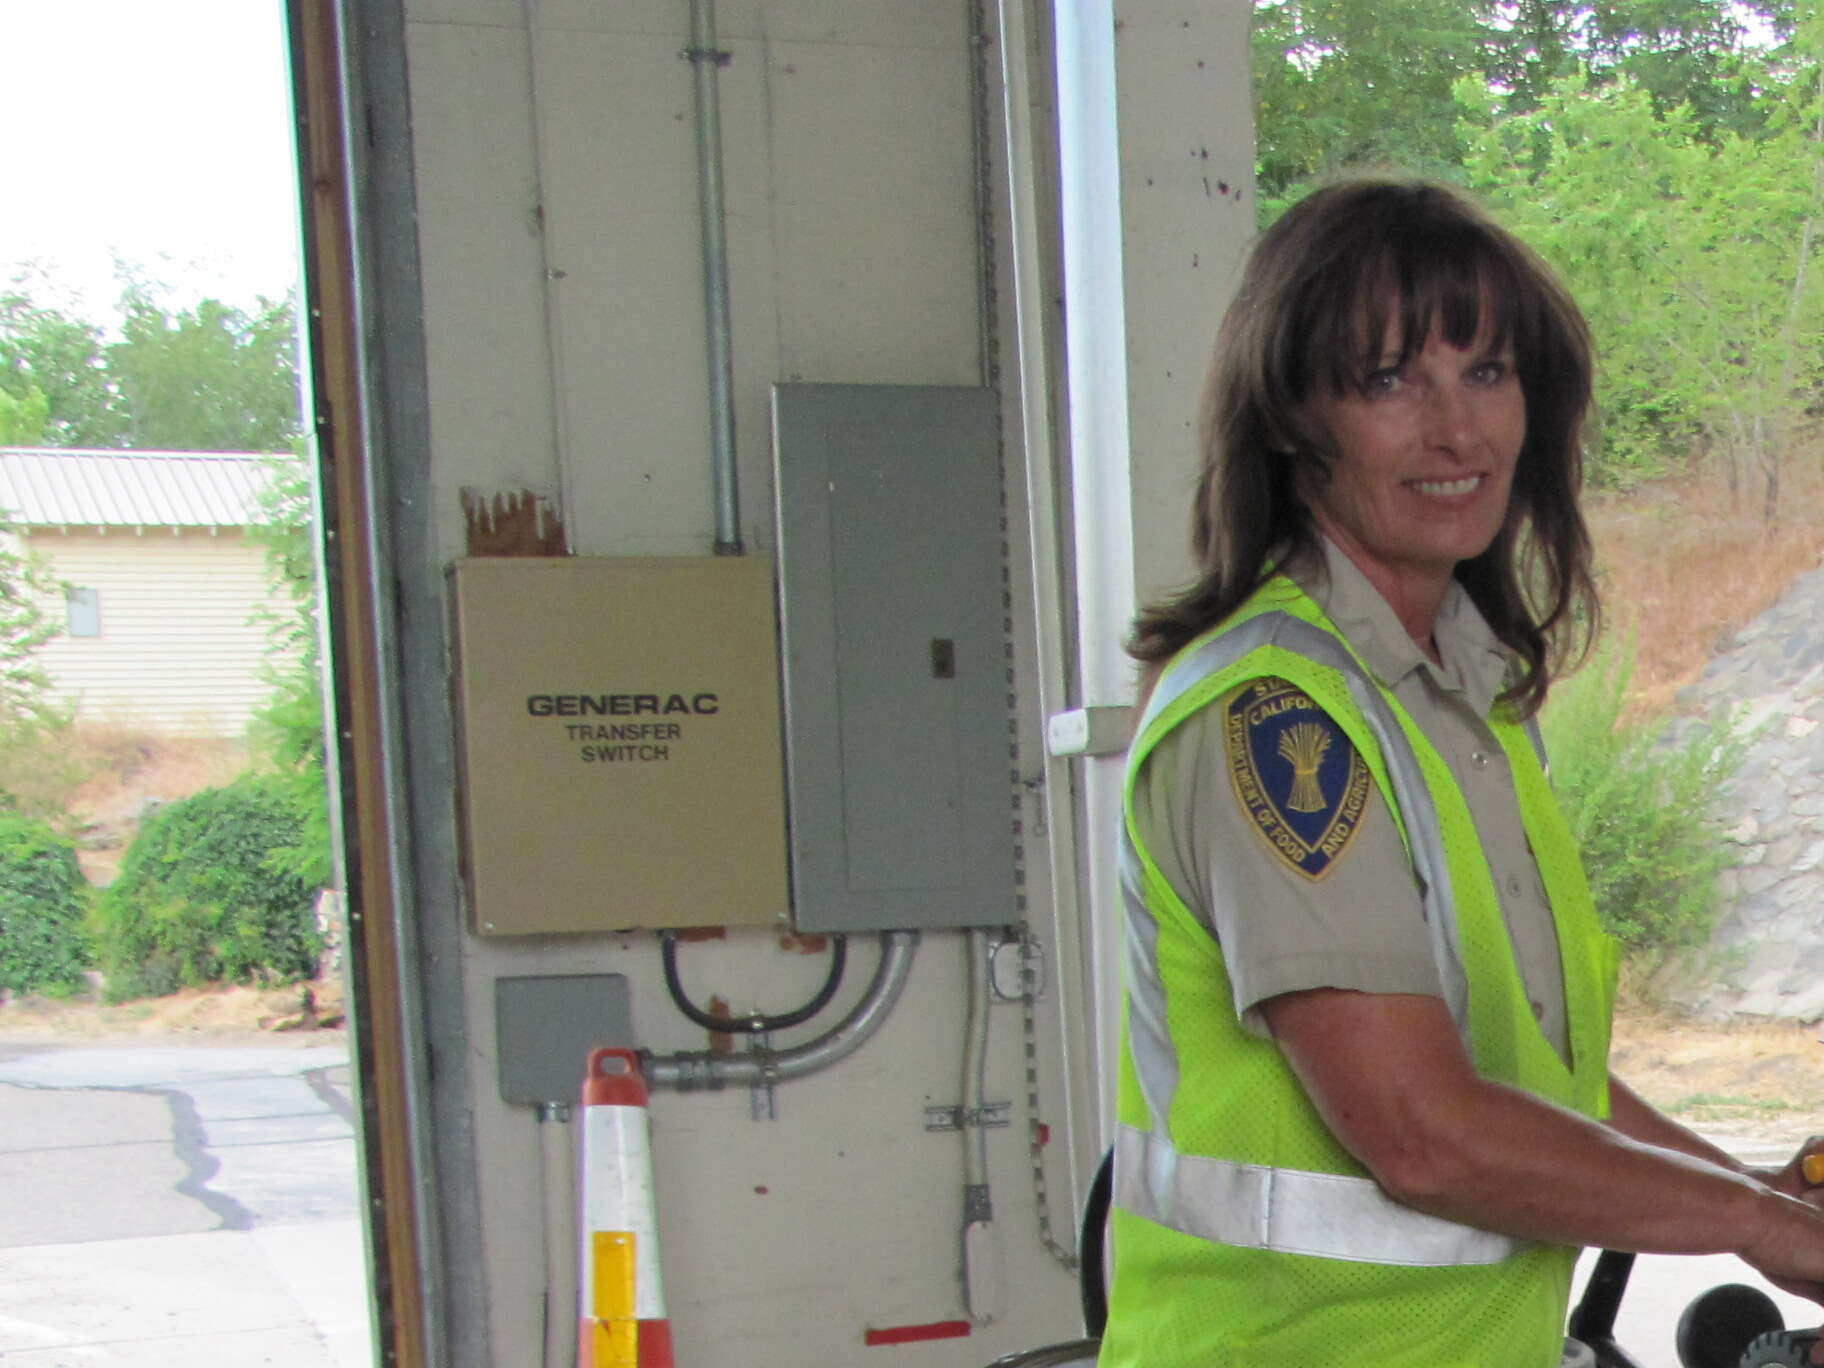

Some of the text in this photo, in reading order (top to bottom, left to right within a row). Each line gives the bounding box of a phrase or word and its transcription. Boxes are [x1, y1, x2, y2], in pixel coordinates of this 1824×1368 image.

[527, 693, 720, 716] GENERAC
[566, 723, 681, 741] TRANSFER
[581, 745, 669, 762] SWITCH
[1270, 825, 1306, 862] FOOD
[1321, 824, 1350, 858] AND
